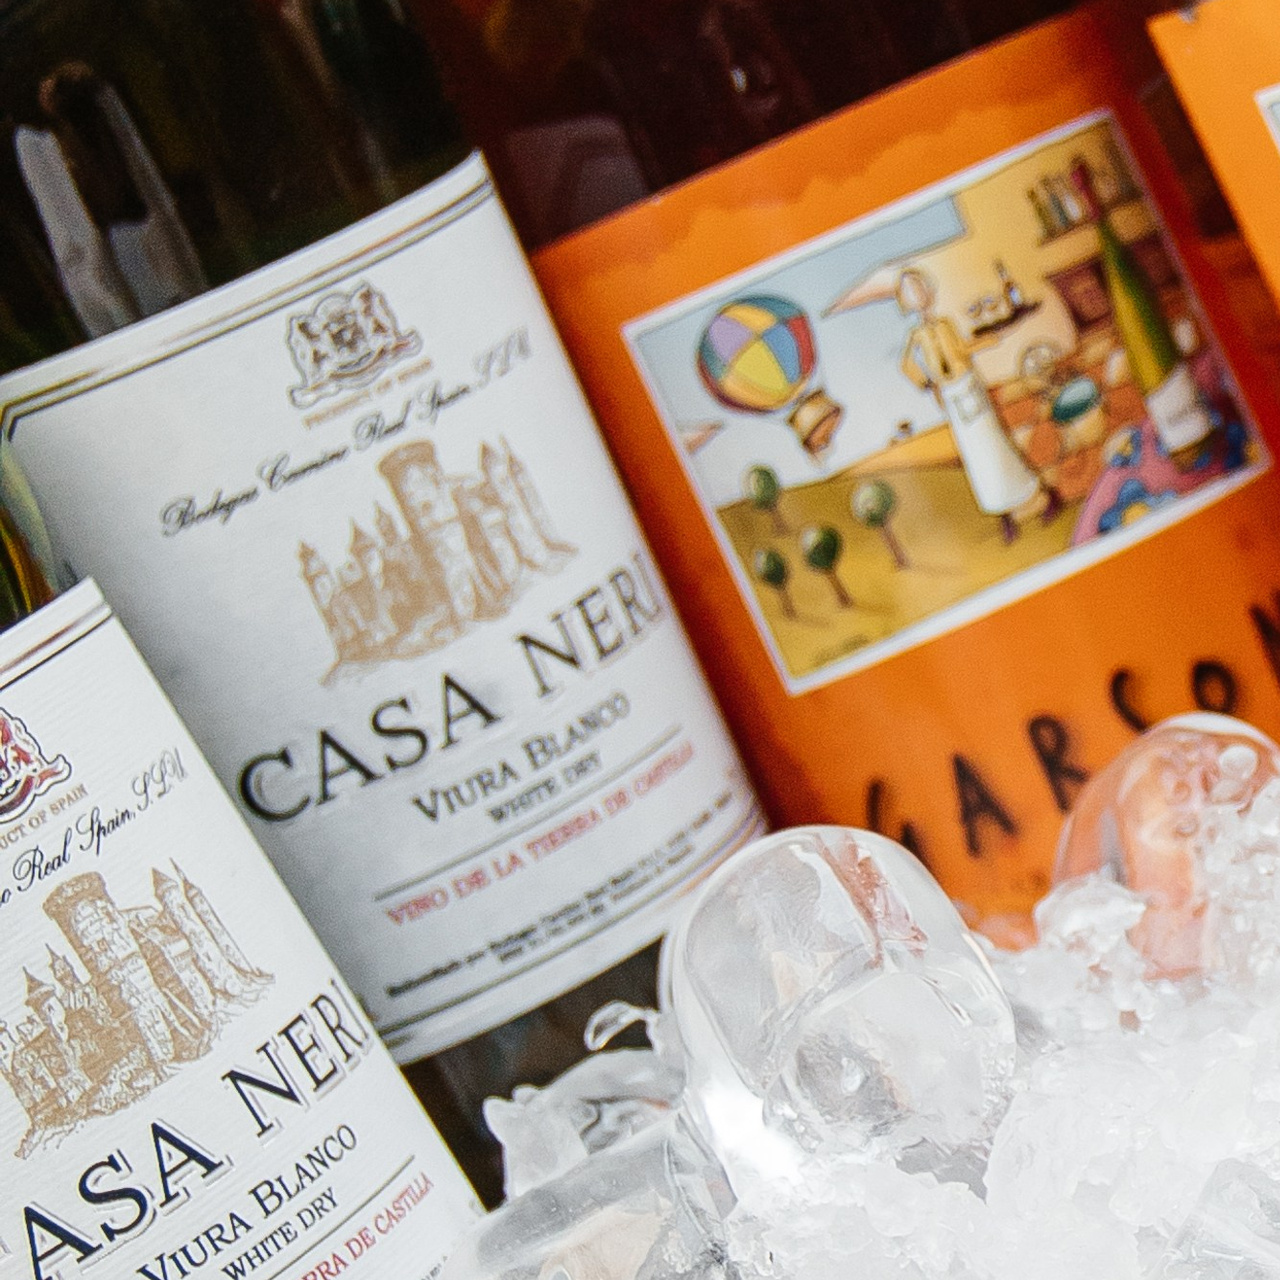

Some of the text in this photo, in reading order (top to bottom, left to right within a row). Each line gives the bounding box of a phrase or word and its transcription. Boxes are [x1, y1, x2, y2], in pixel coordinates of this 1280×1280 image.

[237, 673, 501, 821] CASA
[28, 783, 89, 829] OF SPAIN
[12, 827, 72, 892] Real
[386, 886, 449, 926] VINO
[452, 868, 491, 899] DE
[491, 851, 524, 878] LA
[296, 1187, 339, 1231] DRY
[344, 1227, 377, 1260] DE
[374, 1172, 435, 1235] CASTILLA
